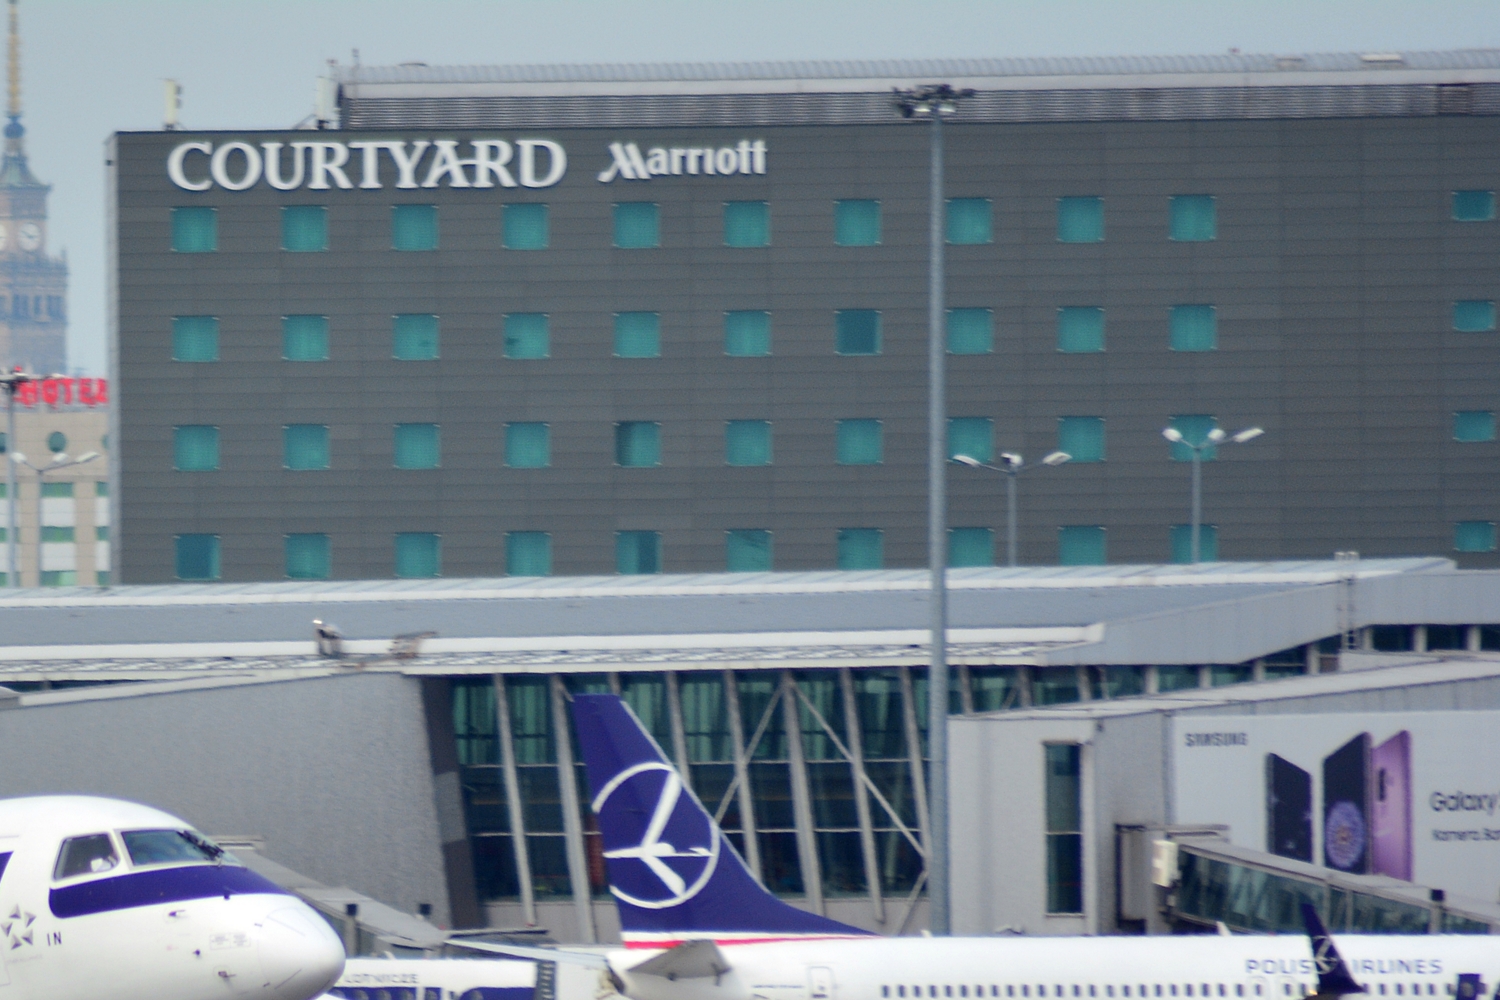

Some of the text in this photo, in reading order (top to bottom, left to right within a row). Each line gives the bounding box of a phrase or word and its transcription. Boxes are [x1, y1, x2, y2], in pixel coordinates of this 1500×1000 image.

[167, 139, 767, 191] COURTYARD Marriott
[14, 378, 108, 406] HOTEL
[1429, 791, 1498, 816] Galaxy
[47, 931, 62, 947] IN
[1245, 959, 1443, 974] POLIS IRLINES
